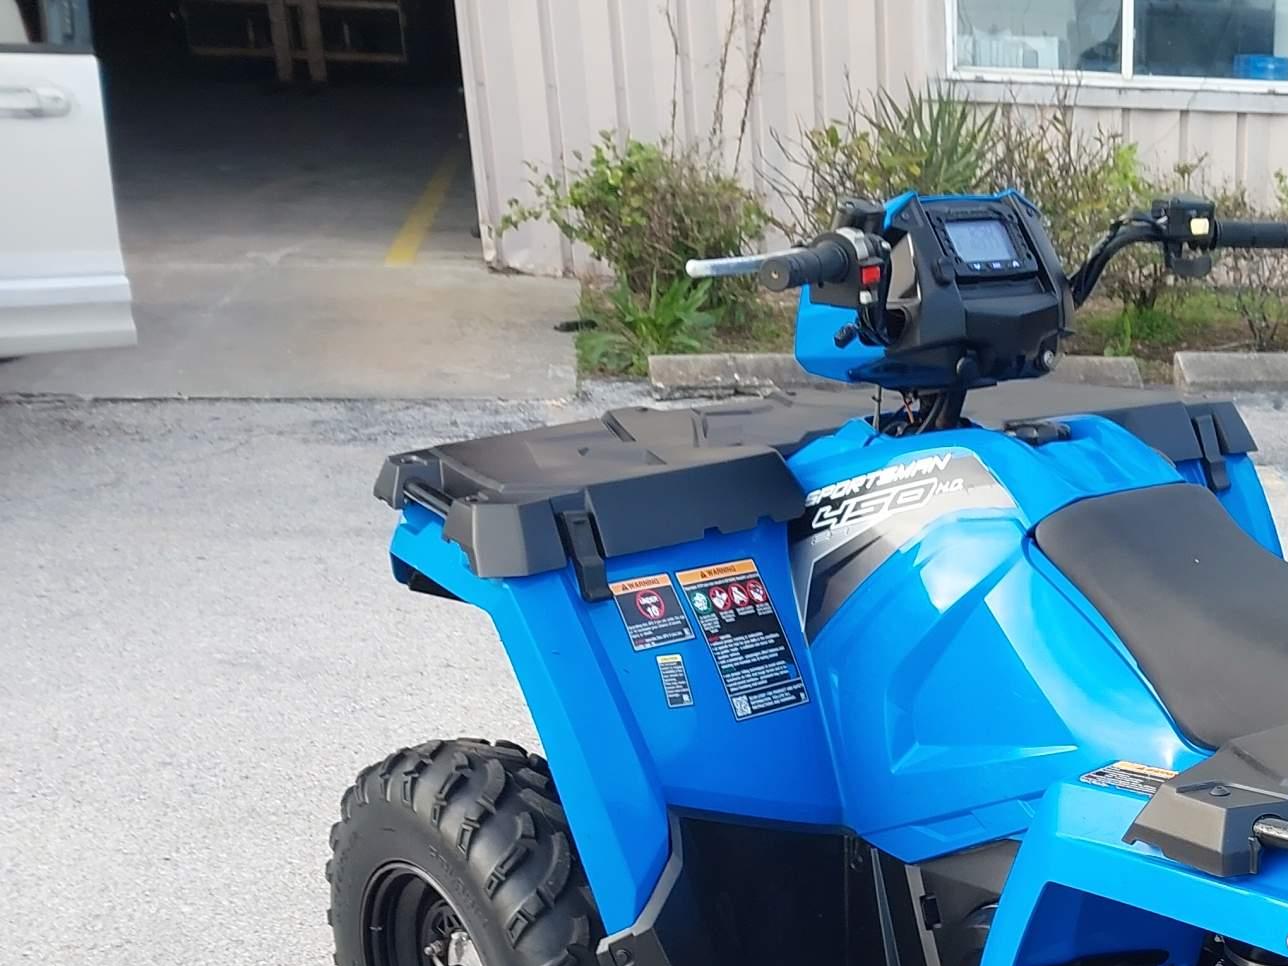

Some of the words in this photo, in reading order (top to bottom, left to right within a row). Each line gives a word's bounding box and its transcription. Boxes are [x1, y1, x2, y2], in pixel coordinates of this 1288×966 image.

[805, 454, 952, 507] SPORTSMAN
[812, 477, 938, 529] 450
[628, 578, 661, 590] WARNING
[707, 565, 737, 577] WARNING
